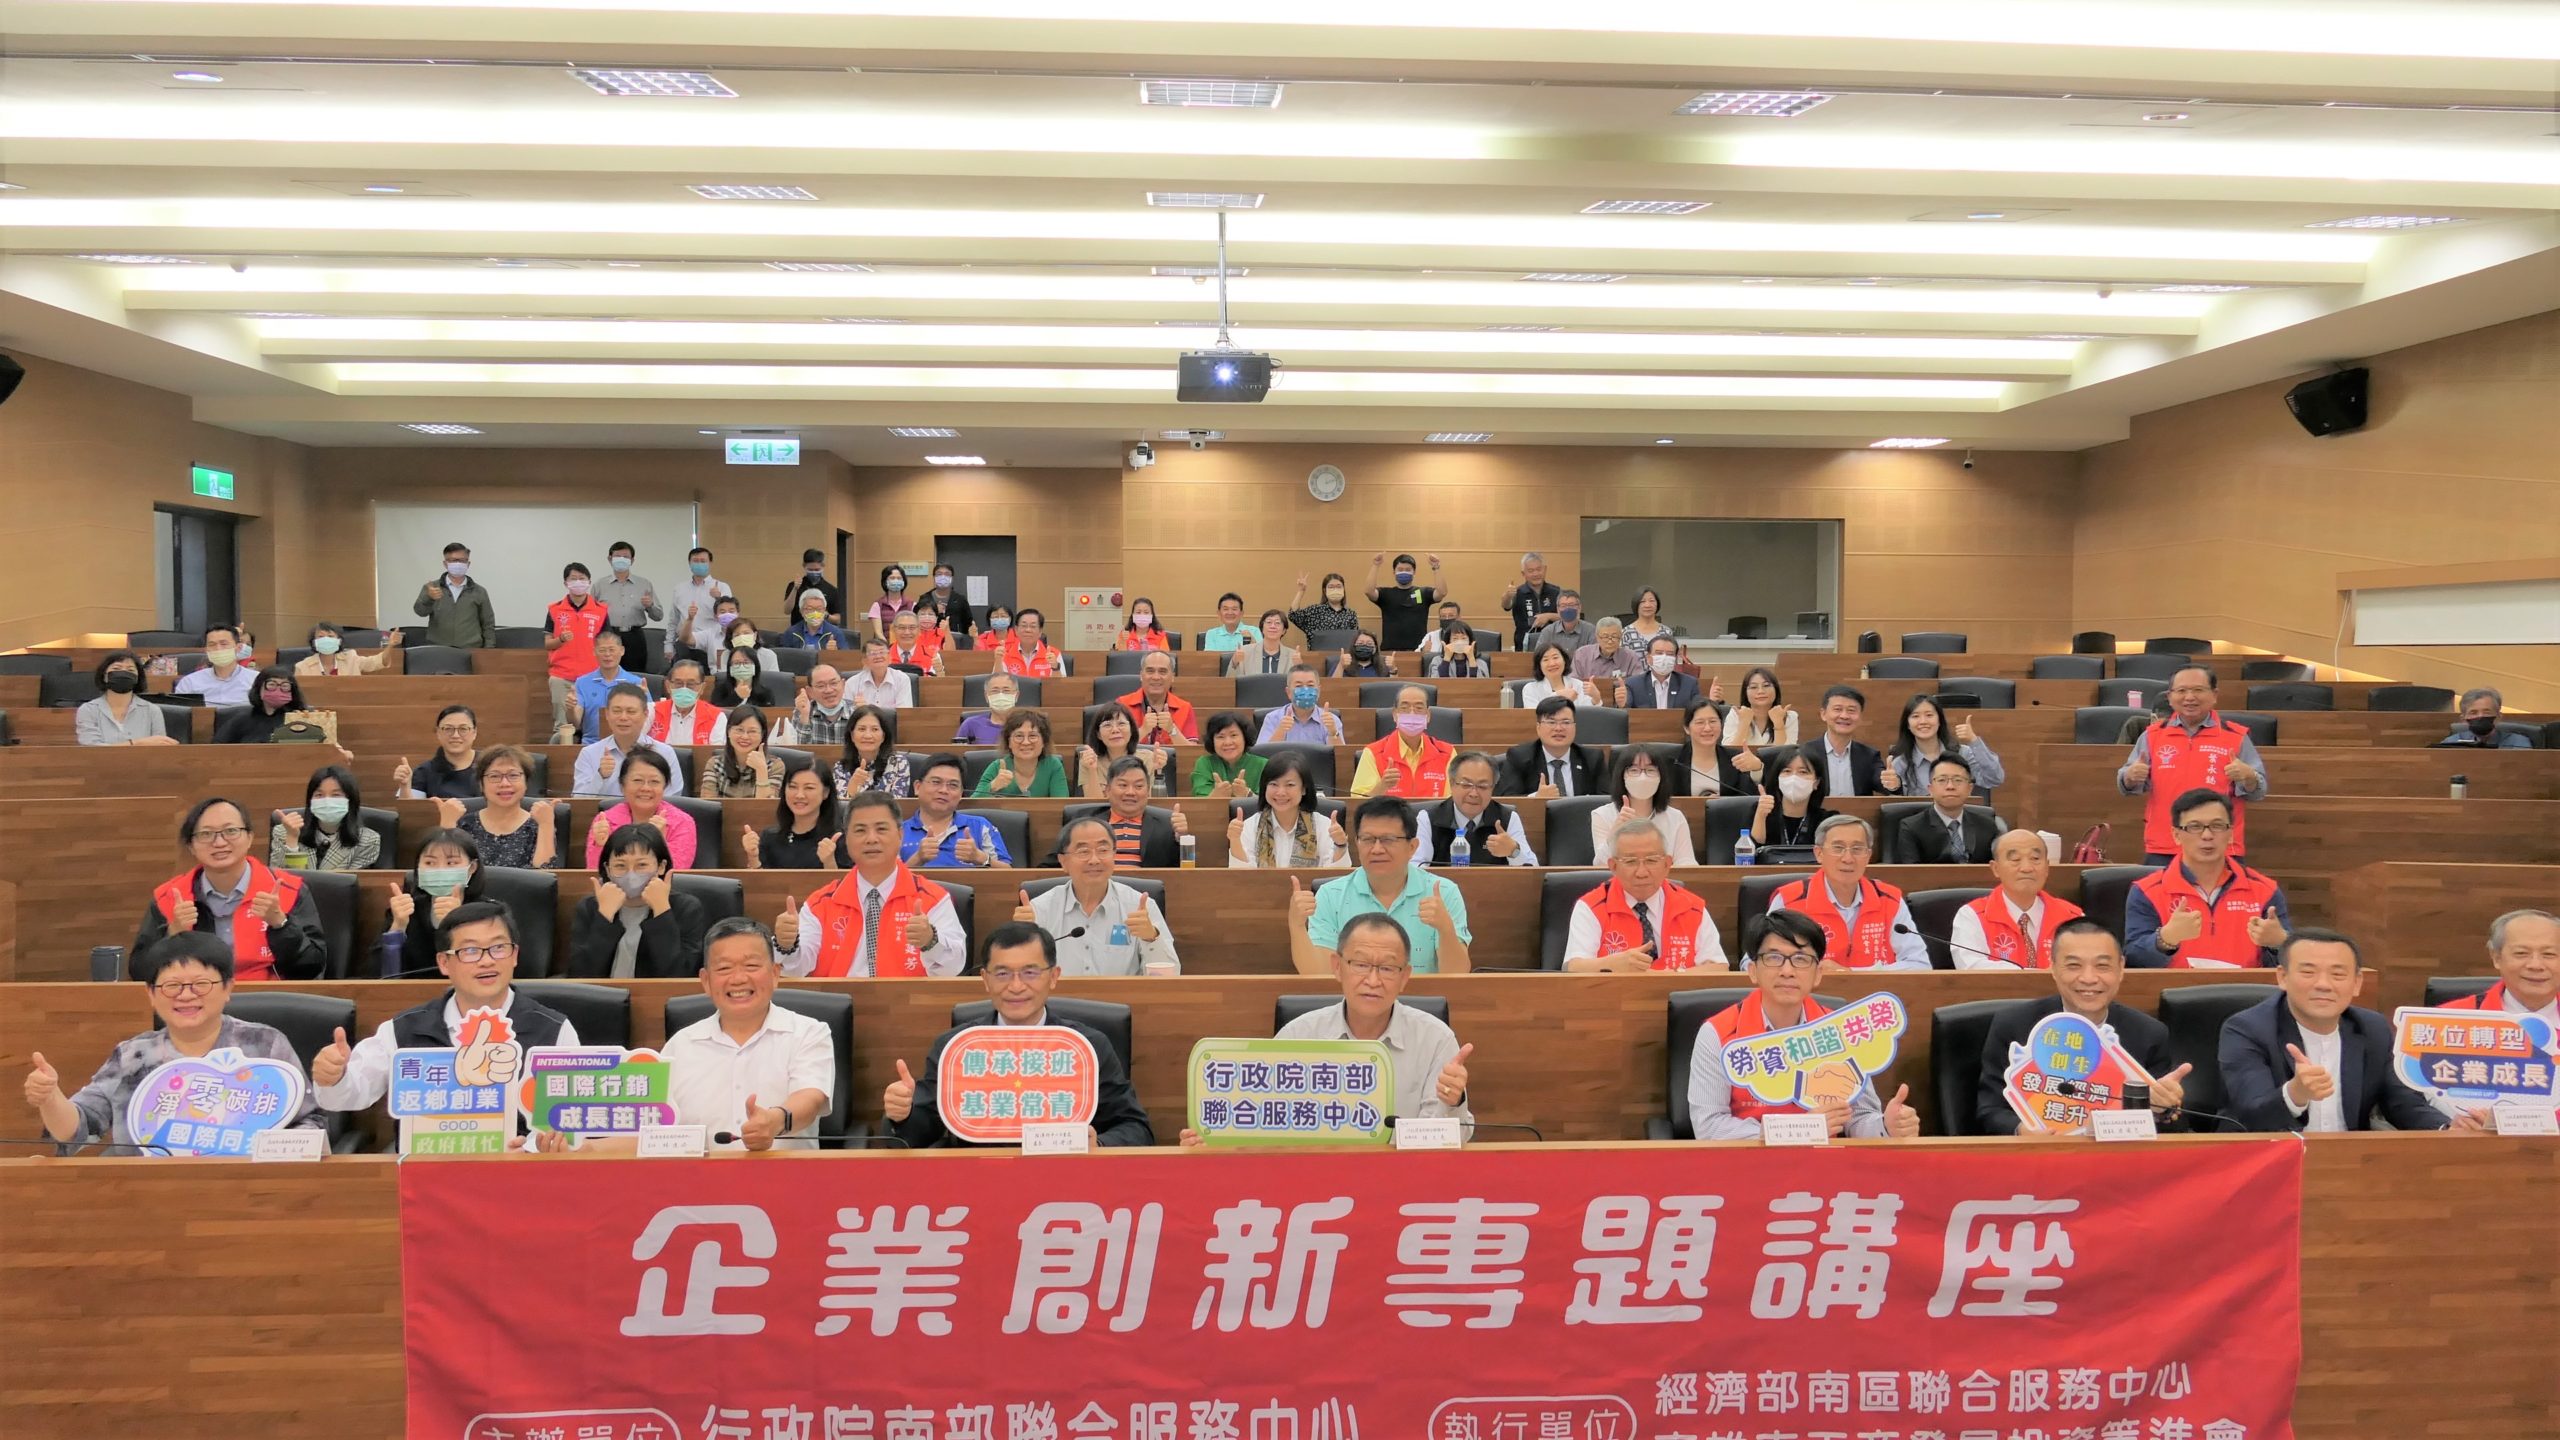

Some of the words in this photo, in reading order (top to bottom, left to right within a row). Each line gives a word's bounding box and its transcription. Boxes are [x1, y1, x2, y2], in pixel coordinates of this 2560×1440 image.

[1727, 1000, 1897, 1076] 勞資和諧共榮
[2042, 1028, 2084, 1050] 在地
[2411, 1023, 2526, 1051] 數位轉型
[400, 1057, 449, 1087] 青年
[536, 1057, 613, 1067] INTERNATIONAL
[961, 1048, 1076, 1077] 傳承接班
[2049, 1051, 2090, 1074] 創生
[2431, 1059, 2549, 1088] 企業成長
[545, 1074, 649, 1098] 國際行銷
[1204, 1061, 1375, 1092] 行政院南部
[153, 1075, 279, 1116] 淨零碳排
[397, 1087, 499, 1112] 返鄉創業
[960, 1090, 1077, 1118] 基業常青
[438, 1120, 478, 1131] GOOD
[558, 1104, 663, 1130] 成長茁壯
[1202, 1099, 1378, 1128] 聯合服務中心
[2043, 1100, 2103, 1126] 提升
[415, 1133, 499, 1154] 政府幫忙
[619, 1191, 2081, 1338] 企業創新專題講座
[1655, 1361, 2191, 1416] 經濟部南區聯合服務中心
[1445, 1408, 1621, 1440] 執行單位
